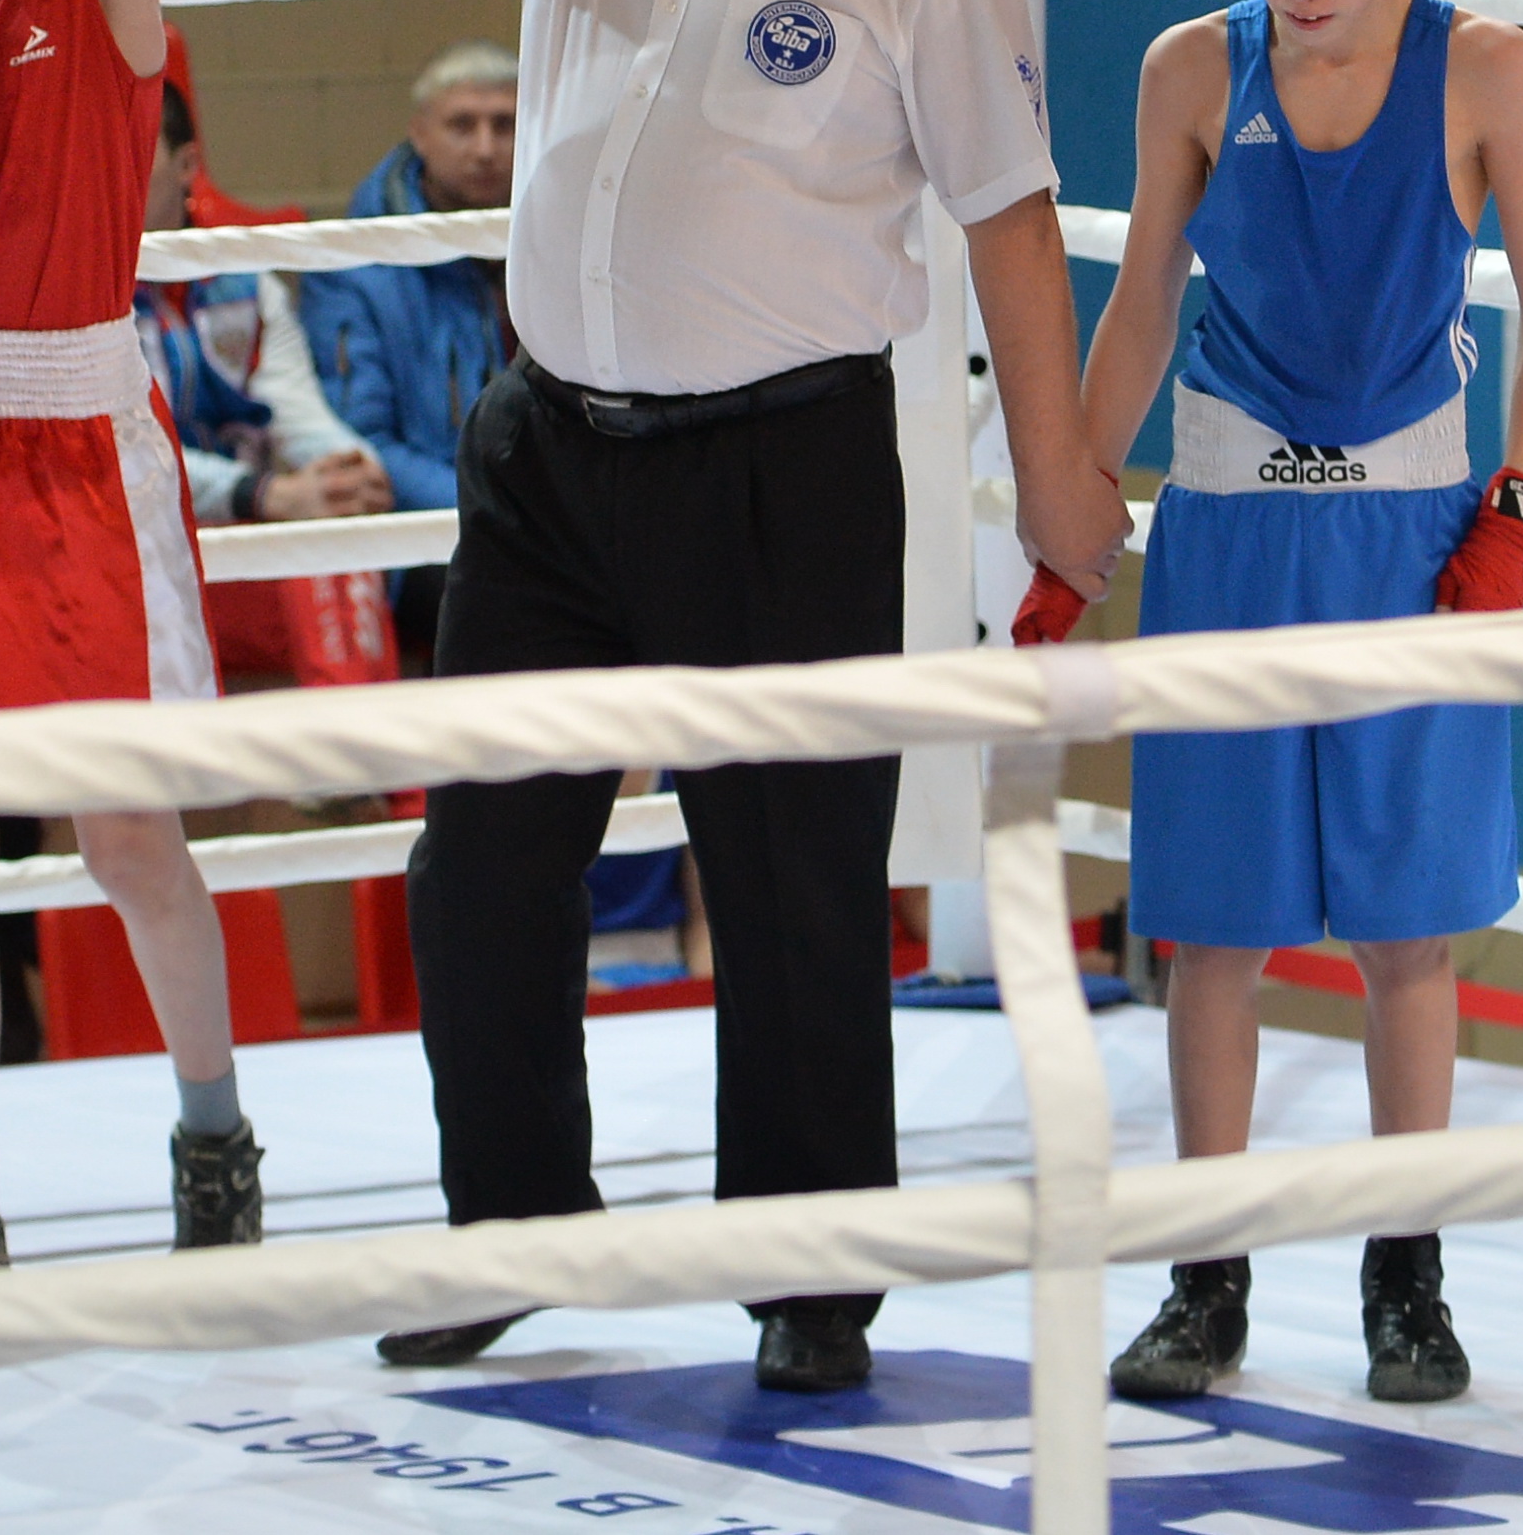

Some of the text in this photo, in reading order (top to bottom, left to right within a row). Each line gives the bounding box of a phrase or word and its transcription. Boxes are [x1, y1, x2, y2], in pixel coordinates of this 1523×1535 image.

[771, 28, 811, 52] aiba
[1234, 132, 1278, 145] adidas
[1258, 460, 1367, 484] adidas
[243, 1430, 558, 1492] 1946
